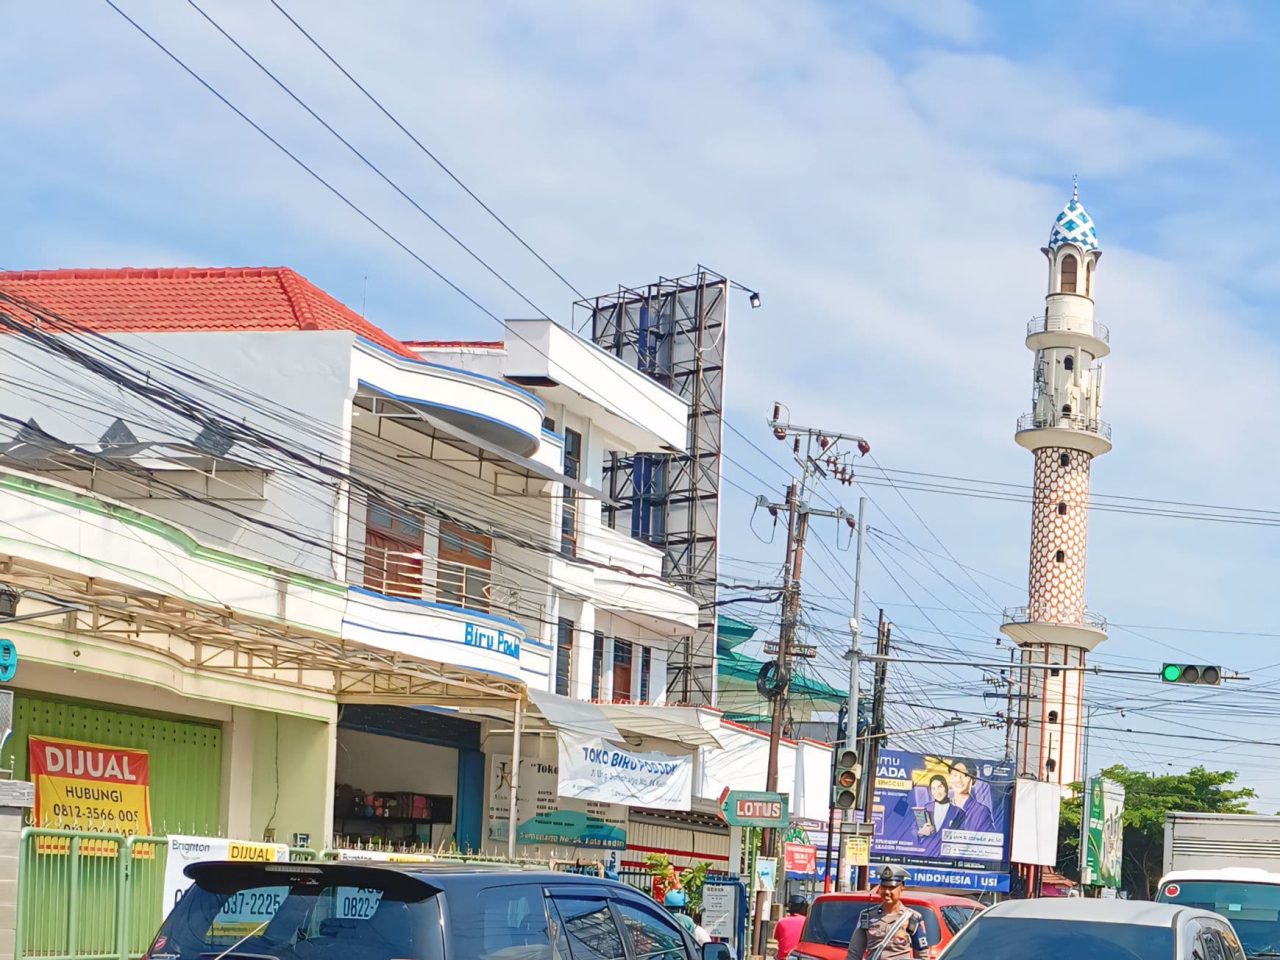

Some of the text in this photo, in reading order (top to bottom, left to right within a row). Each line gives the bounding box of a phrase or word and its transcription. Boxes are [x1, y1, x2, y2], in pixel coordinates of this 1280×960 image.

[45, 746, 136, 781] DIJUAL
[582, 747, 609, 764] TOKO
[65, 786, 123, 803] HUBUNGI
[736, 801, 781, 816] LOTUS
[172, 839, 211, 853] Brighton
[231, 845, 271, 861] DIJUAL
[913, 872, 998, 887] INDONESIA USI
